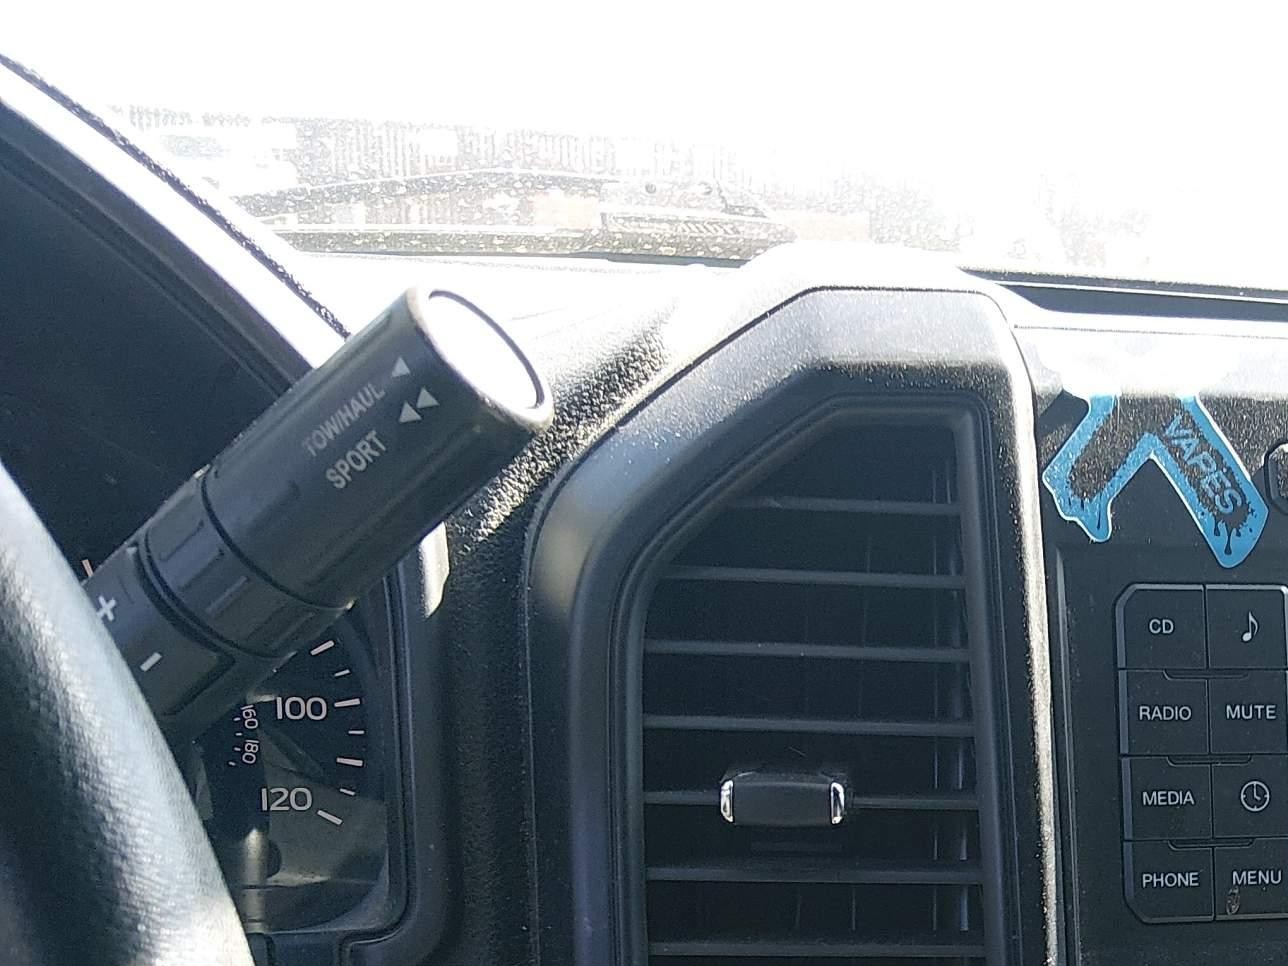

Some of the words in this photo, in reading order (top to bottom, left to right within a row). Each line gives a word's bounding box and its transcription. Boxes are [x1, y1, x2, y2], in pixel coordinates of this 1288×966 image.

[303, 383, 386, 457] TOW/HAUL
[326, 430, 386, 488] SPORT
[1163, 414, 1242, 513] VAPES
[1149, 619, 1175, 634] CD
[240, 704, 259, 729] 160
[276, 696, 328, 721] 100
[1139, 706, 1192, 721] RADIO
[1226, 704, 1277, 720] MUTE
[241, 739, 260, 764] 180
[261, 787, 313, 811] 120
[1142, 791, 1195, 806] MEDIA
[1142, 872, 1200, 888] PHONE
[1232, 870, 1282, 885] MENU
